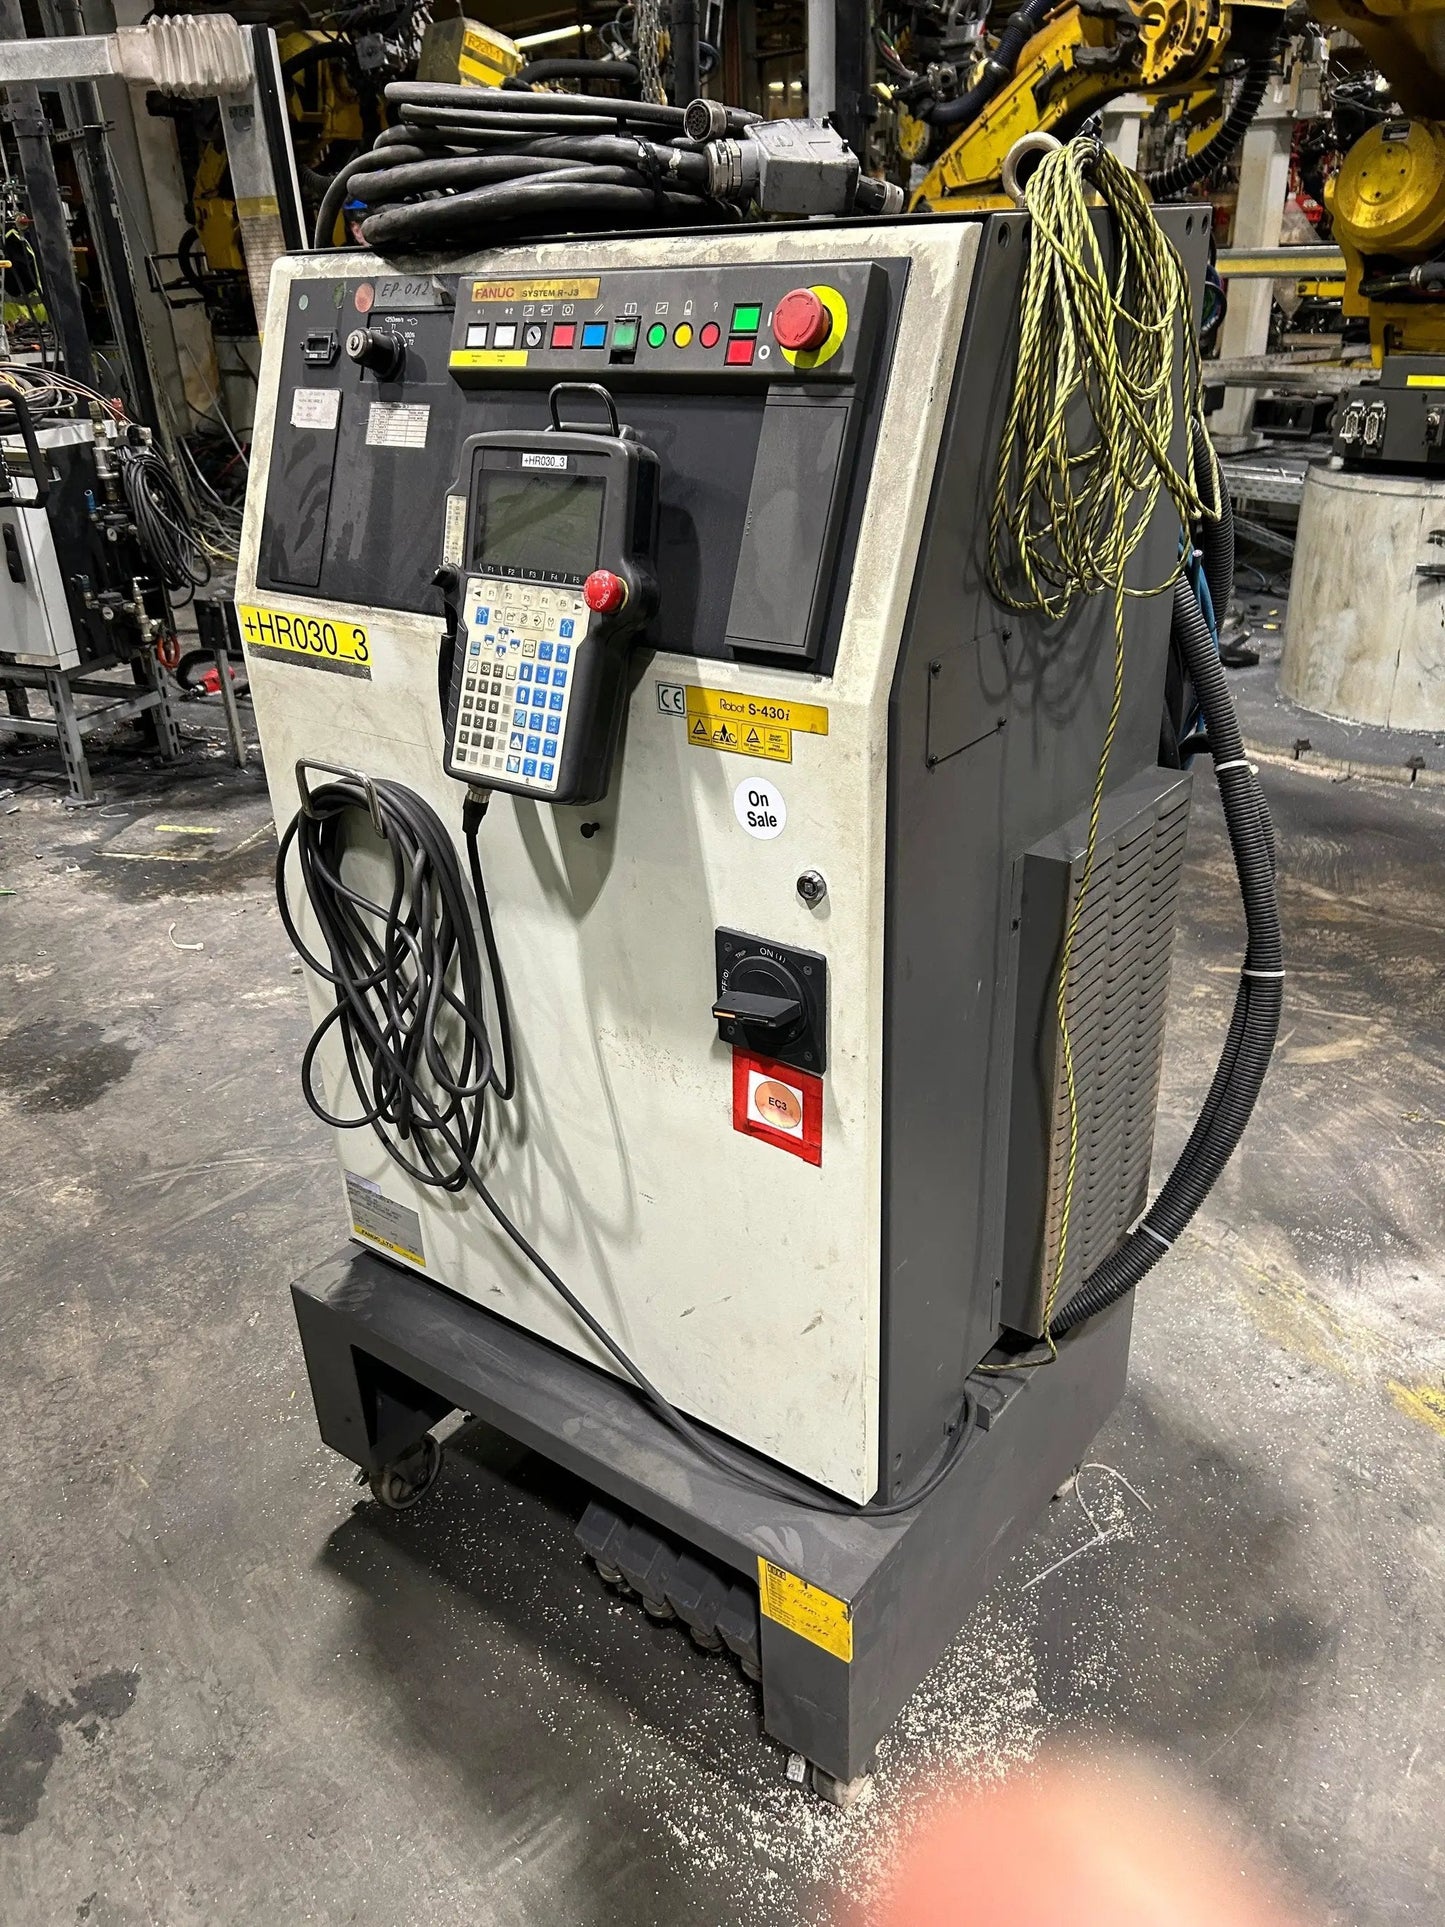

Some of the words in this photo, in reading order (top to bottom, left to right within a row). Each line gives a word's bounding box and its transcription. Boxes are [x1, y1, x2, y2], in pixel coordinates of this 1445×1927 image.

[381, 280, 430, 298] EP-012
[475, 287, 515, 299] FANUC
[521, 289, 555, 298] SYSTEM
[557, 288, 579, 297] R-J3
[524, 455, 566, 468] +HR030_3
[487, 565, 495, 573] F1
[508, 567, 516, 576] F2
[528, 570, 537, 578] F3
[550, 573, 559, 581] F4
[572, 575, 580, 584] F5
[505, 592, 513, 600] F2
[244, 611, 369, 662] +HR030_3
[719, 698, 745, 713] Robot
[748, 703, 791, 721] S-430i
[748, 790, 769, 807] On
[747, 811, 778, 828] Sale
[768, 1096, 787, 1112] EC3
